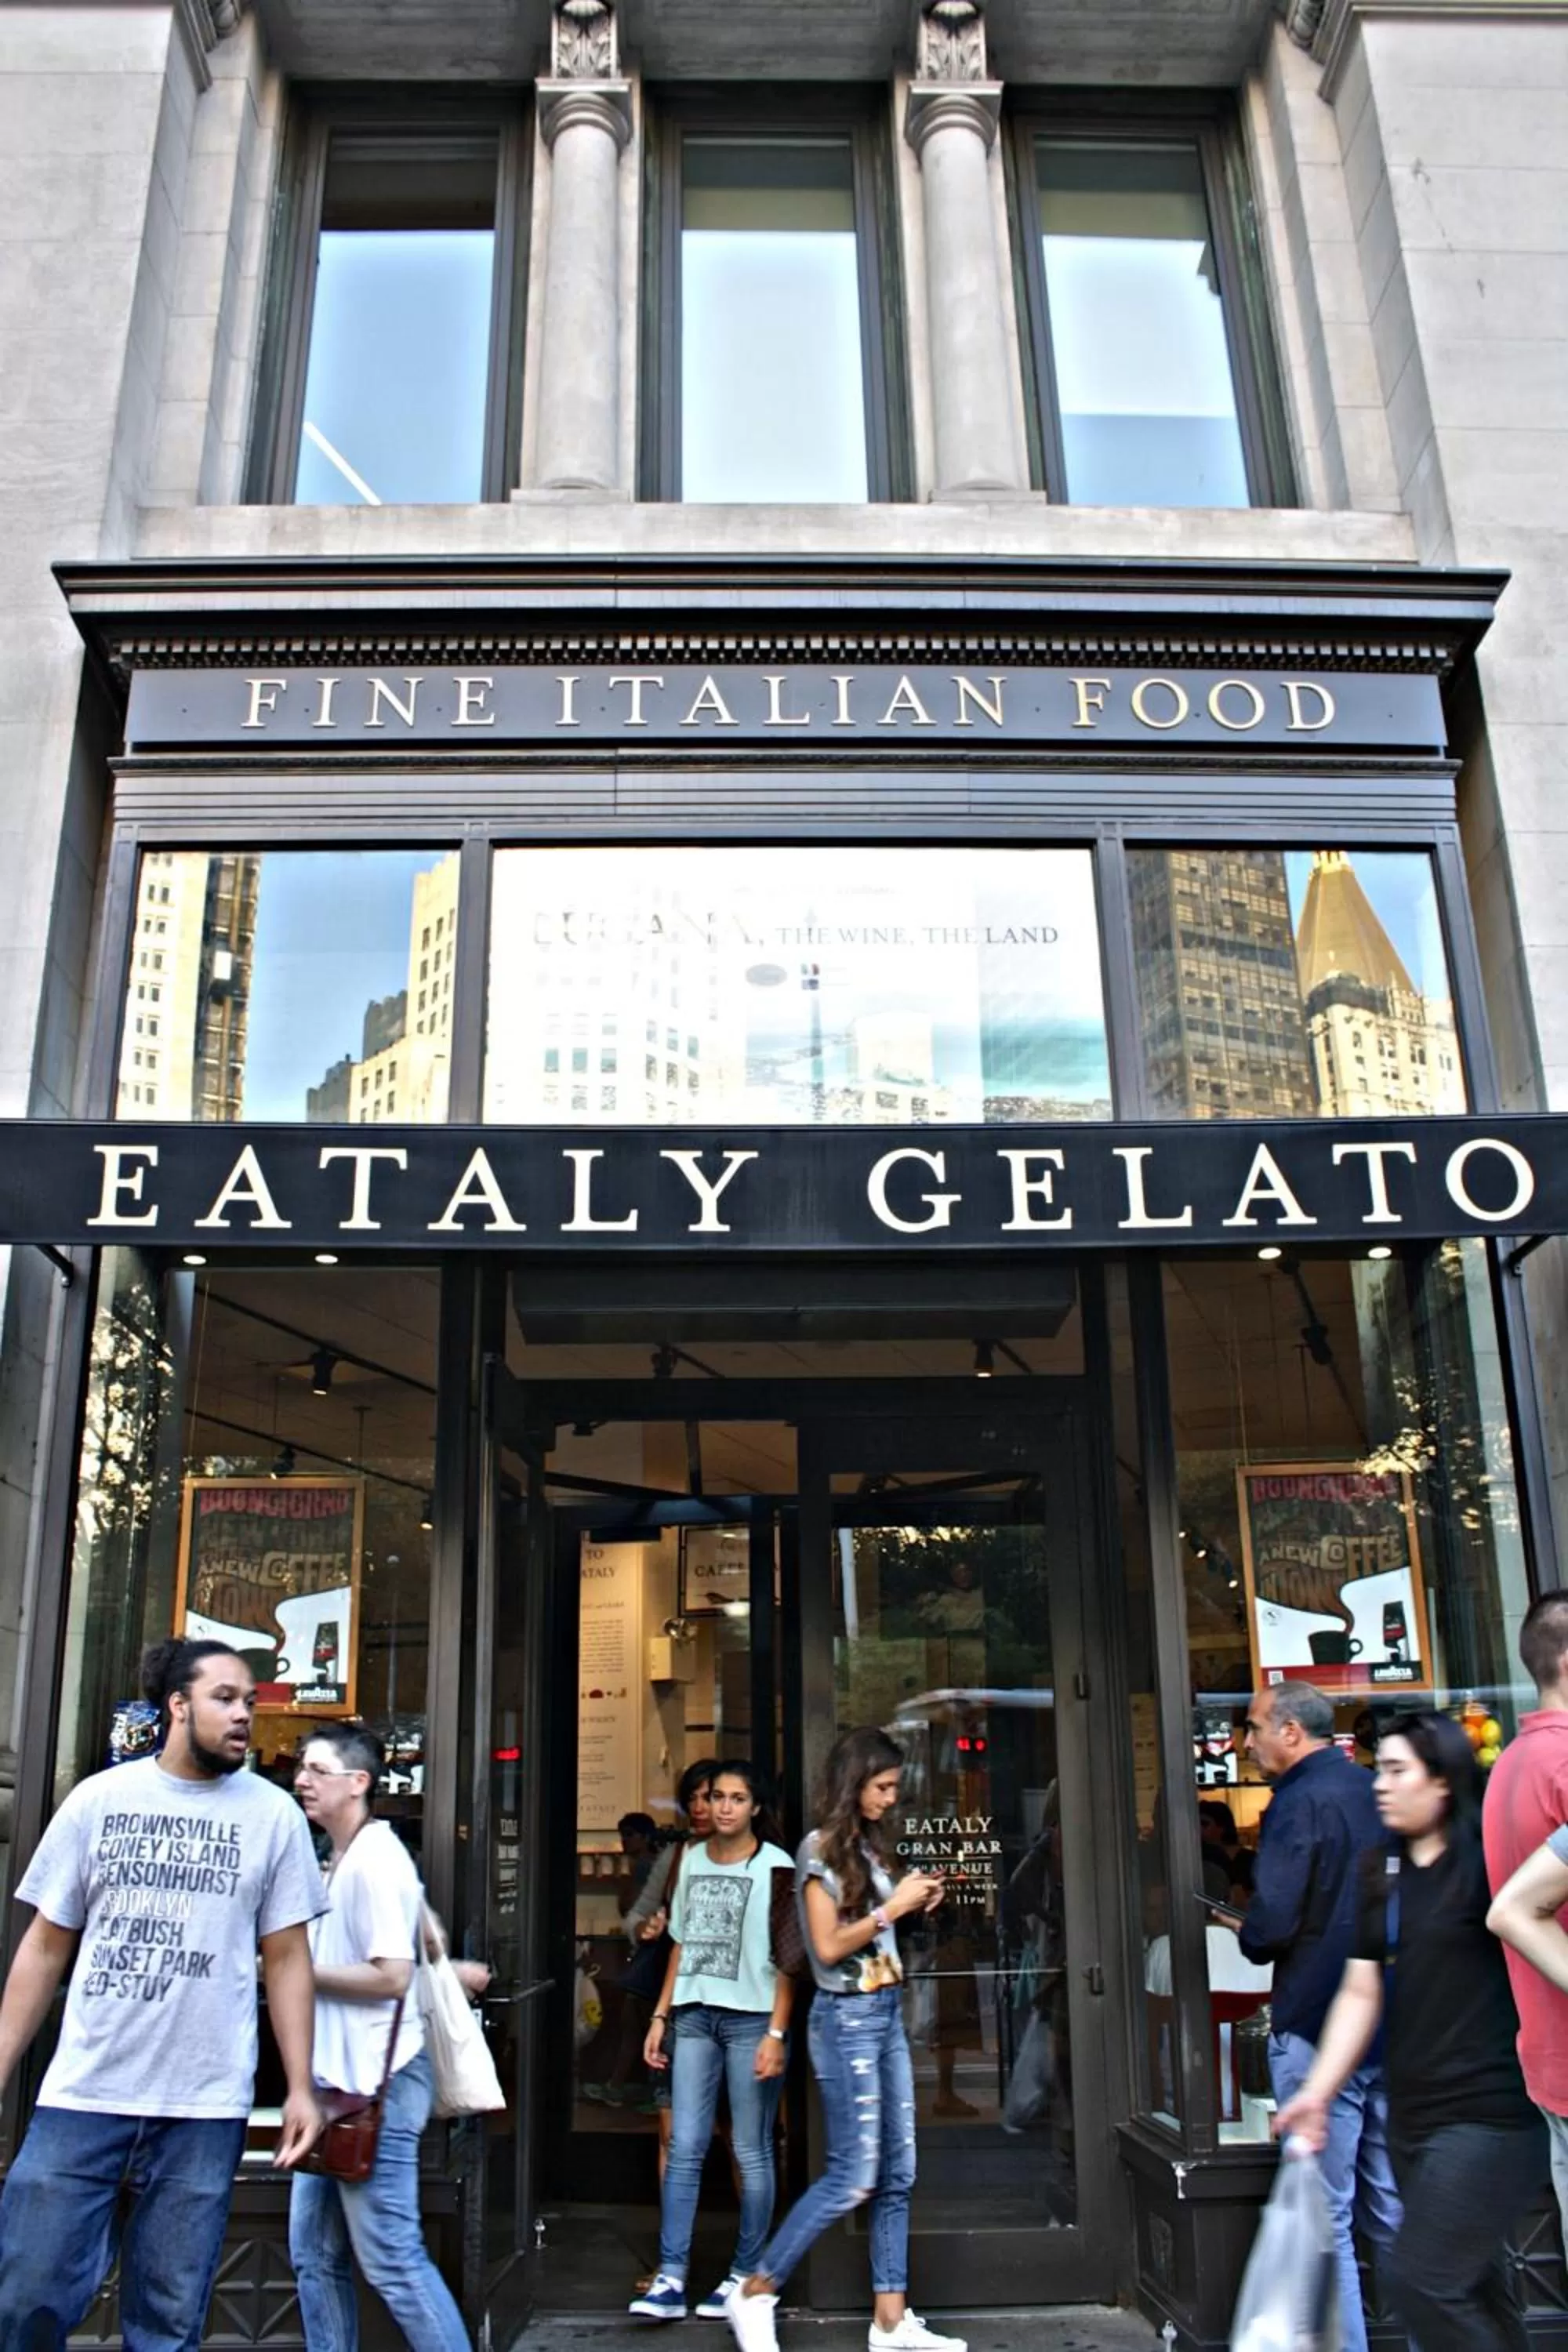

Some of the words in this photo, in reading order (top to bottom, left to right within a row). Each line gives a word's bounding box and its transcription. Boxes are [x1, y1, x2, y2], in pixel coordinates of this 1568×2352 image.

[240, 677, 495, 728] FINE
[554, 675, 1008, 728] ITALIAN
[1069, 677, 1336, 731] FOOD
[775, 927, 829, 944] THE
[922, 927, 978, 944] THE
[985, 927, 1059, 944] LAND
[86, 1144, 759, 1232] EATALY
[867, 1138, 1534, 1233] GELATO
[582, 1567, 615, 1578] ATALY
[1320, 1534, 1404, 1580] COFFEE
[102, 1813, 241, 1845] BROWNSVILLE
[905, 1817, 993, 1835] EATALY
[98, 1837, 163, 1861] CONEY
[167, 1840, 241, 1869] ISLAND
[896, 1842, 953, 1856] GRAN
[962, 1840, 1003, 1854] BAR
[99, 1860, 241, 1896] BENSONHURST
[159, 1949, 216, 1978] PARK
